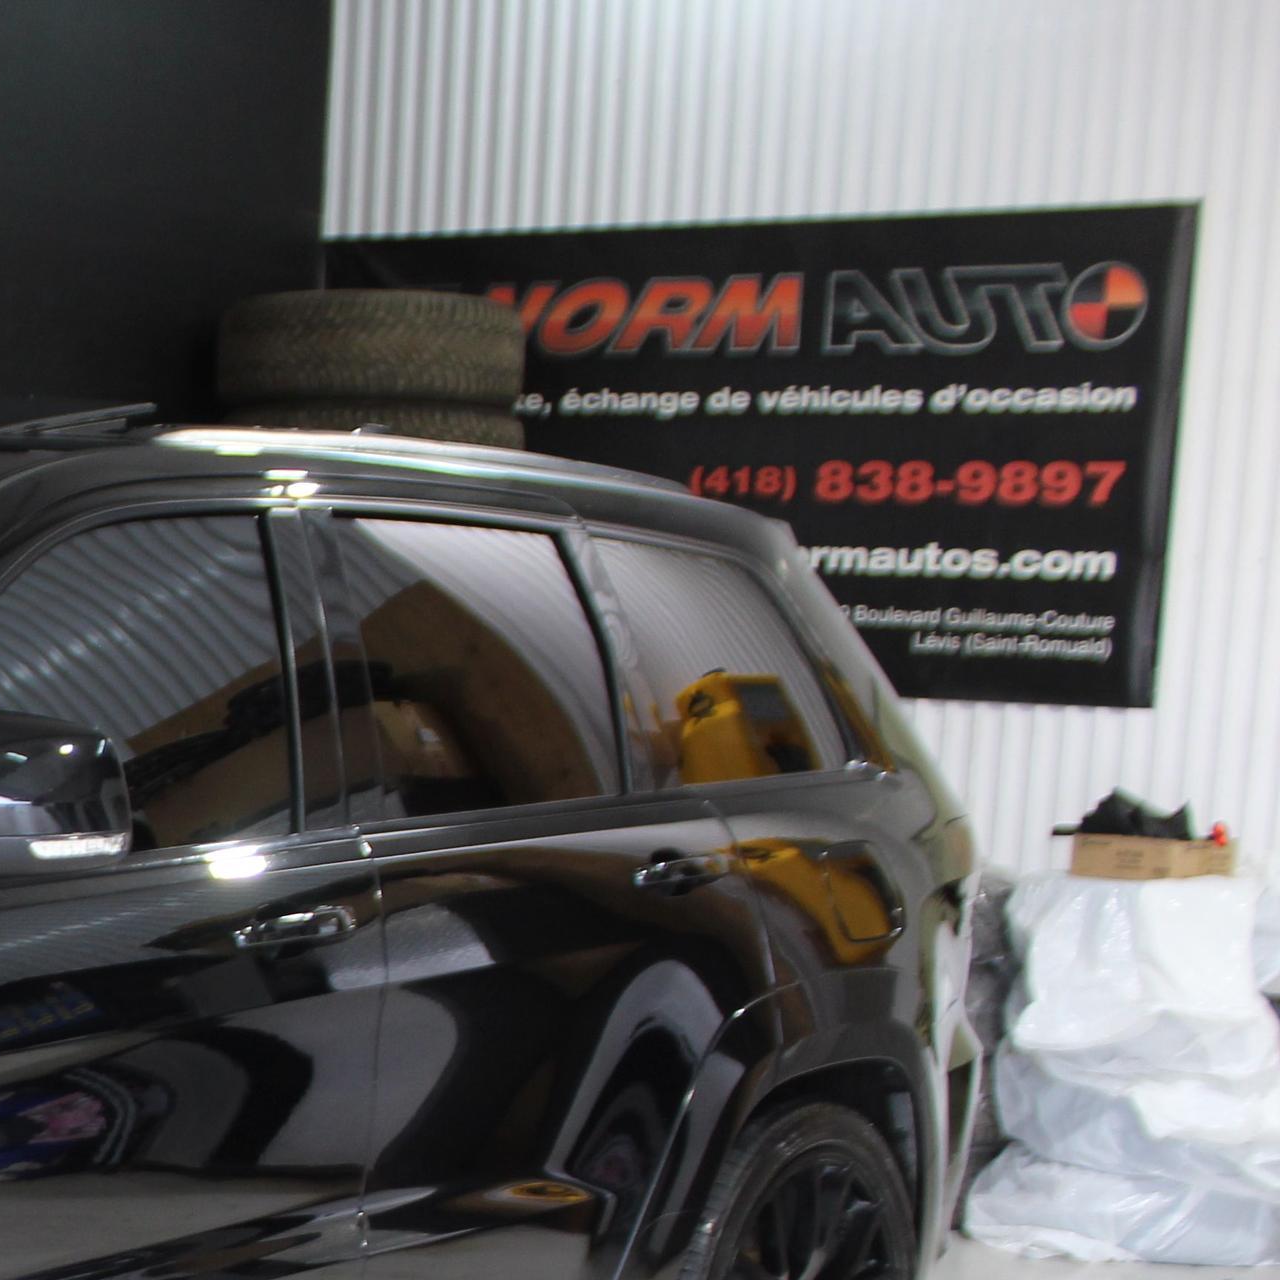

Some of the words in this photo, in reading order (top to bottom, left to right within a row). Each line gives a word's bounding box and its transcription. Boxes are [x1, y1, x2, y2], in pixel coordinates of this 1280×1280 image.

[822, 262, 1148, 354] AUTO
[559, 388, 699, 419] échange
[705, 386, 751, 415] de
[757, 385, 924, 415] véhicules
[929, 382, 1138, 413] d'occasion
[689, 465, 796, 500] (418)
[815, 460, 1127, 507] 838-9897
[853, 604, 941, 627] Boulevard
[944, 606, 1116, 634] Guillaume-Couture
[910, 631, 961, 653] Lévis
[963, 632, 1113, 661] (Saint-Romuald)
